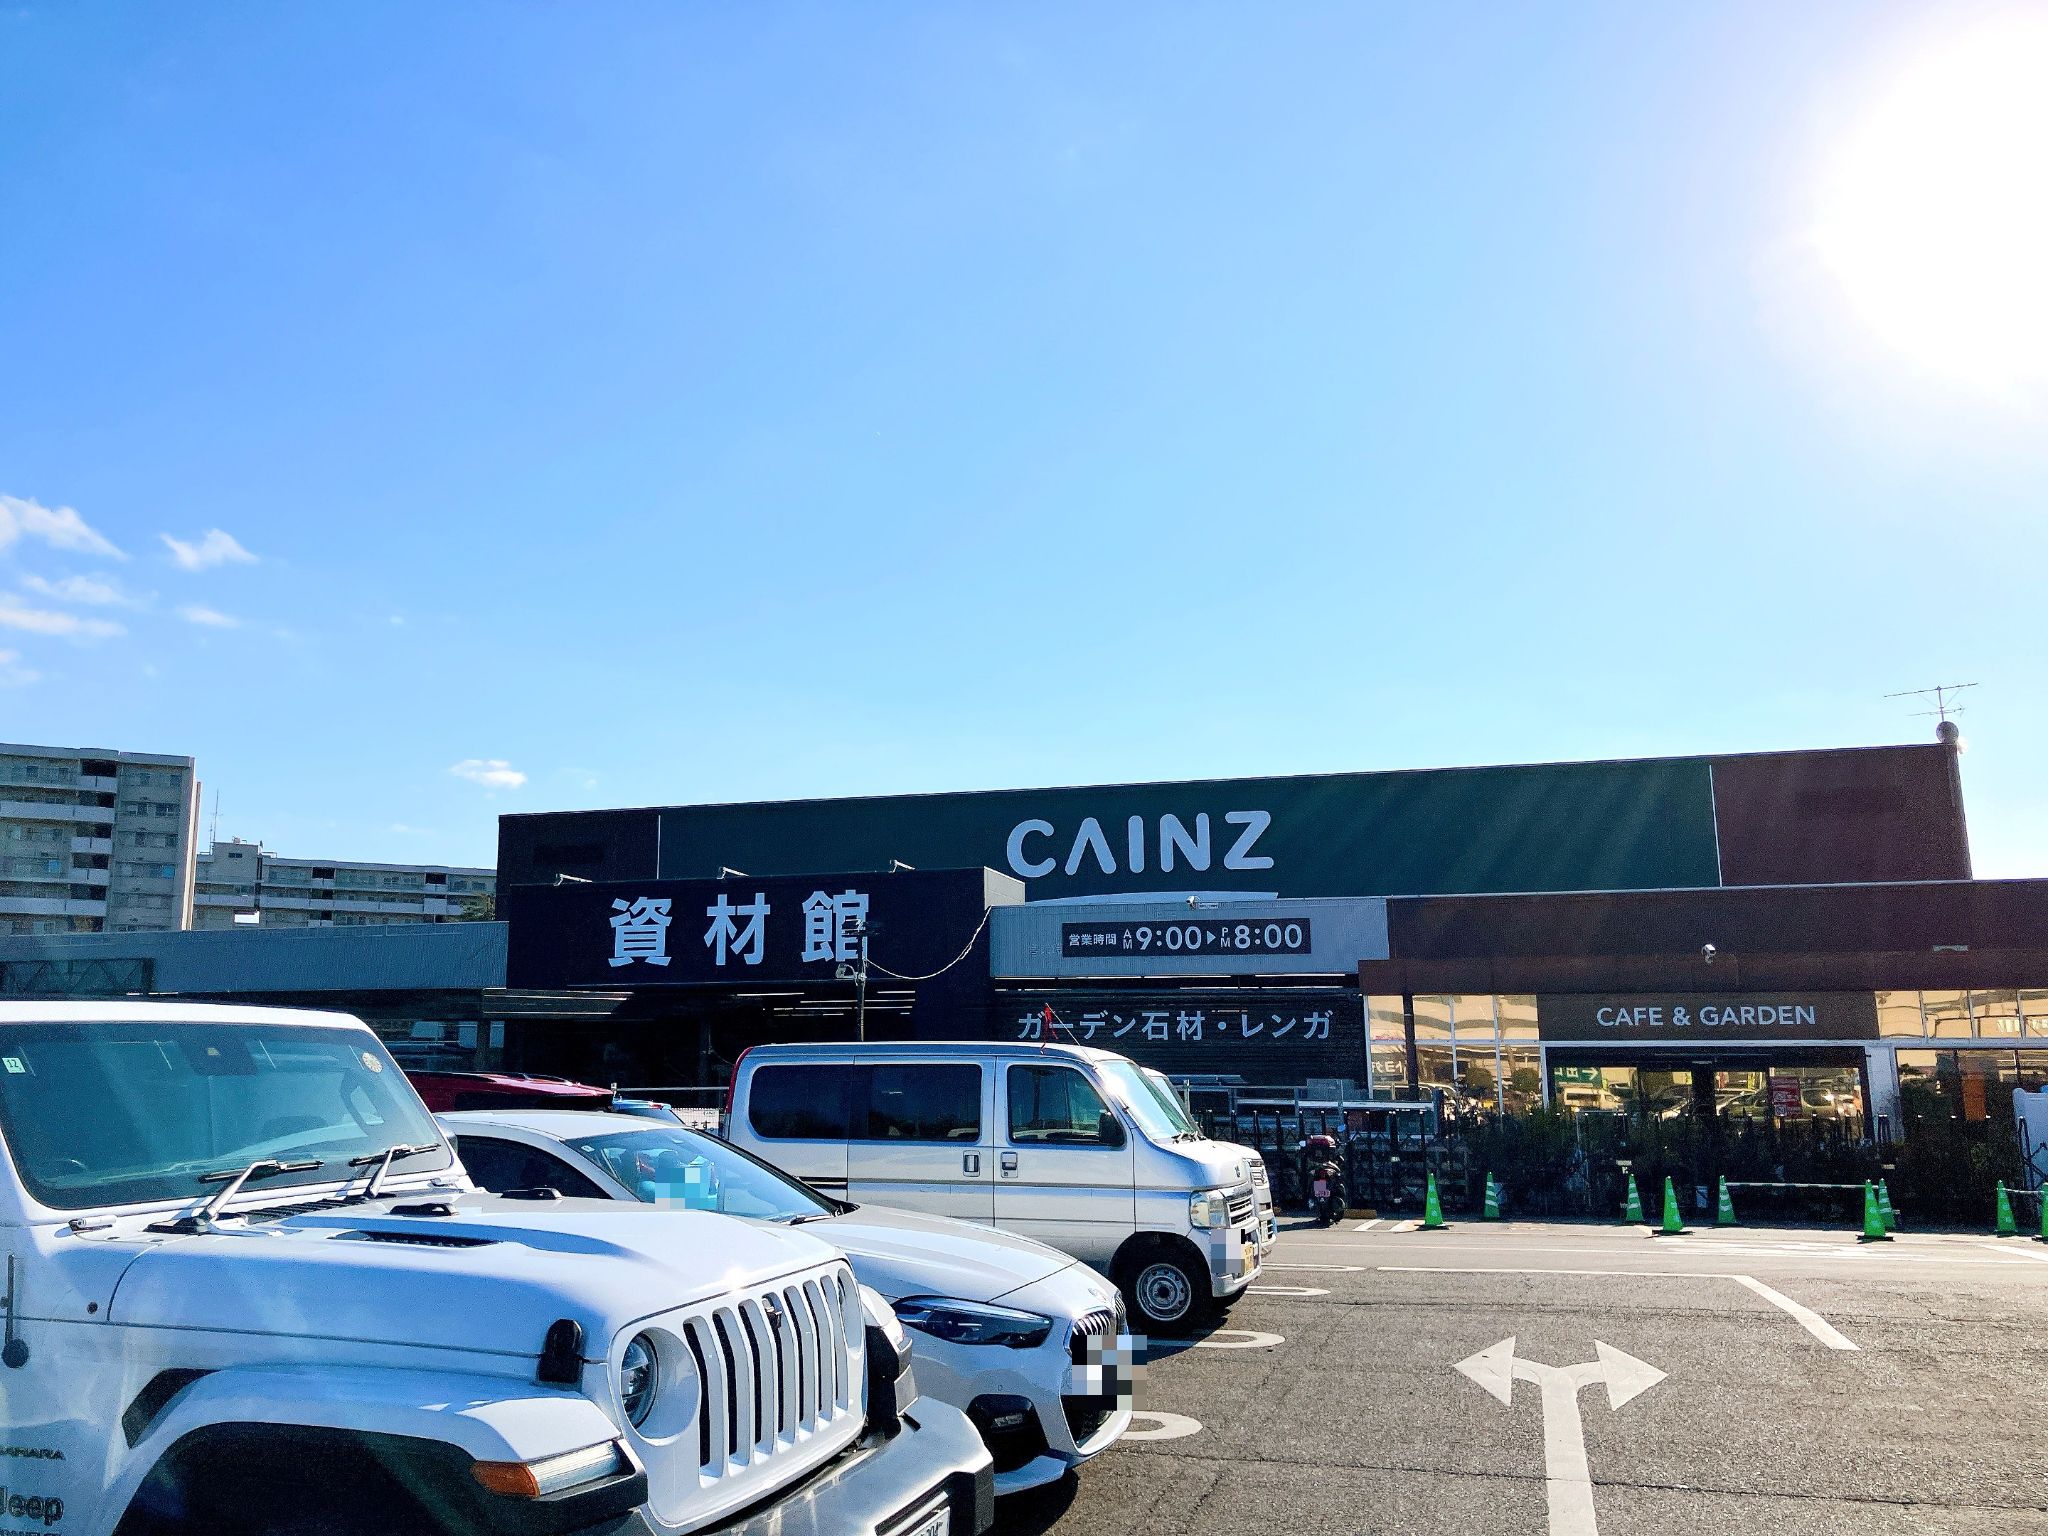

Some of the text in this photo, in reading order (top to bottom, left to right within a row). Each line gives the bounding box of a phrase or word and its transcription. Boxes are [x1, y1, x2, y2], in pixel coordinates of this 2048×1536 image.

[1006, 810, 1274, 878] CAINZ
[607, 889, 869, 967] 資材館
[1068, 933, 1117, 947] 営業時間
[1136, 926, 1202, 950] 9:00
[1234, 923, 1303, 949] 8:00
[1596, 1005, 1816, 1027] CAFE & GARDEN
